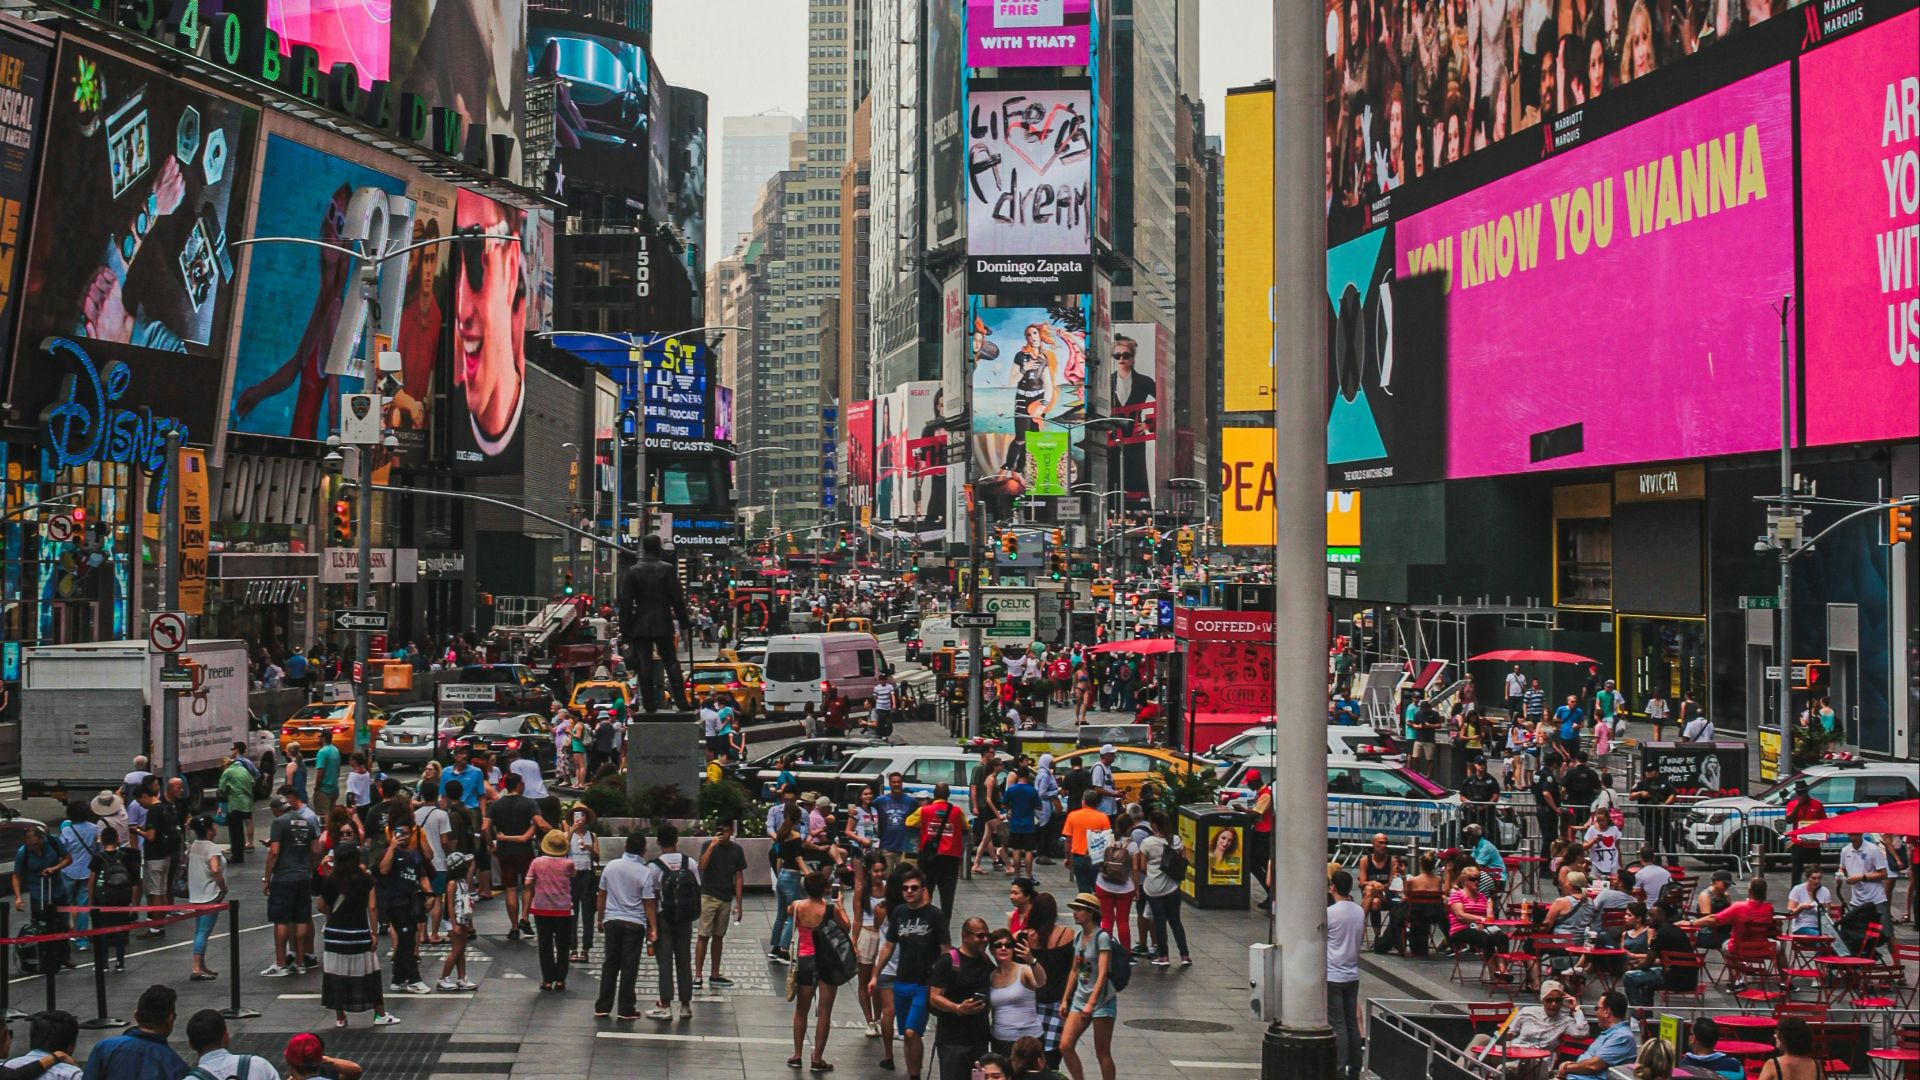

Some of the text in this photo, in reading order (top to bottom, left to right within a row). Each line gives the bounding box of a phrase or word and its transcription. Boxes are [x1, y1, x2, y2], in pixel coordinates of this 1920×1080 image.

[1000, 4, 1039, 16] FRIES
[1824, 7, 1863, 35] MARQUIS
[980, 35, 1076, 49] WITH THAT?
[262, 27, 514, 178] BROADWAY
[1554, 111, 1583, 131] MARRIOTT
[1555, 128, 1580, 147] MARQUIS
[1461, 203, 1542, 289] KNOW
[1550, 177, 1614, 261] YOU
[1624, 124, 1767, 237] WANNA
[636, 236, 649, 297] 1500
[976, 259, 1083, 275] Domingo Zapata
[1000, 275, 1059, 283] @domingozapata
[218, 455, 322, 524] FOREVER
[1640, 471, 1678, 494] INVICTA
[184, 506, 201, 521] THE
[673, 535, 713, 544] Cousins
[244, 580, 287, 604] FOREVER
[1001, 599, 1031, 608] CELTIC
[342, 617, 382, 625] ONE WAY
[958, 616, 991, 624] ONE WAY
[1194, 620, 1256, 633] COFFEED
[1369, 809, 1421, 828] NYPD
[1595, 848, 1616, 862] NY
